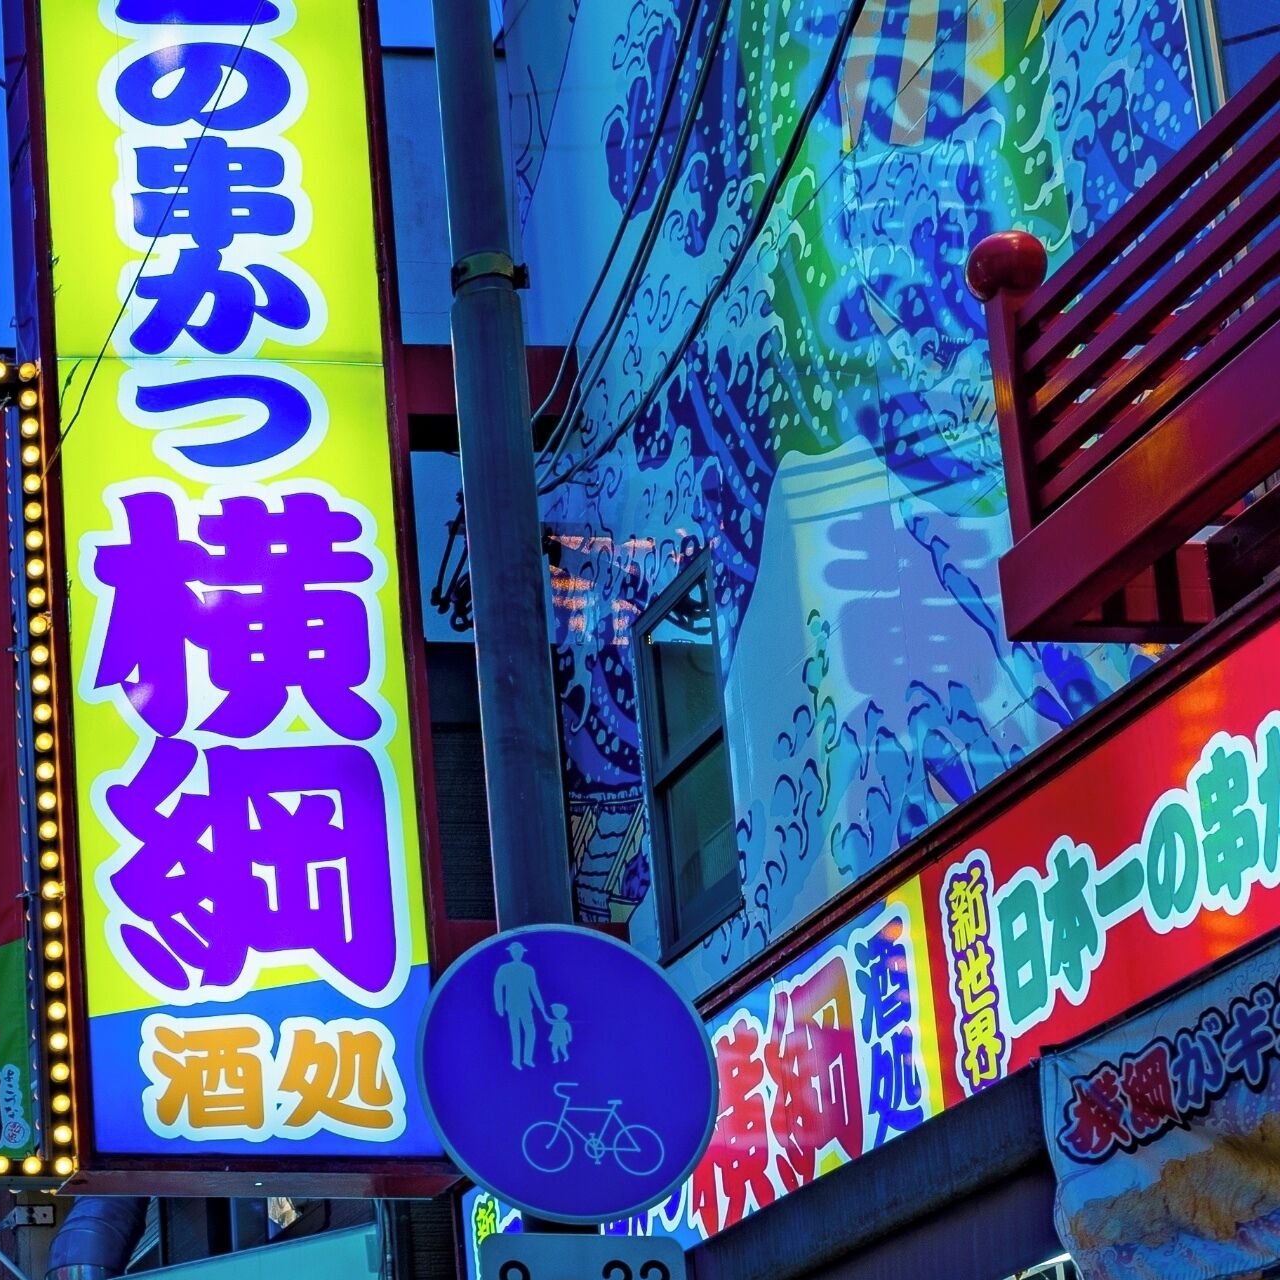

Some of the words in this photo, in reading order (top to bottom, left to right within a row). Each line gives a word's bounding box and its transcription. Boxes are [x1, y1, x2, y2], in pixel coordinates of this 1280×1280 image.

[94, 491, 396, 990] 横綱
[153, 1026, 387, 1130] 酒処
[854, 915, 924, 1150] 酒処
